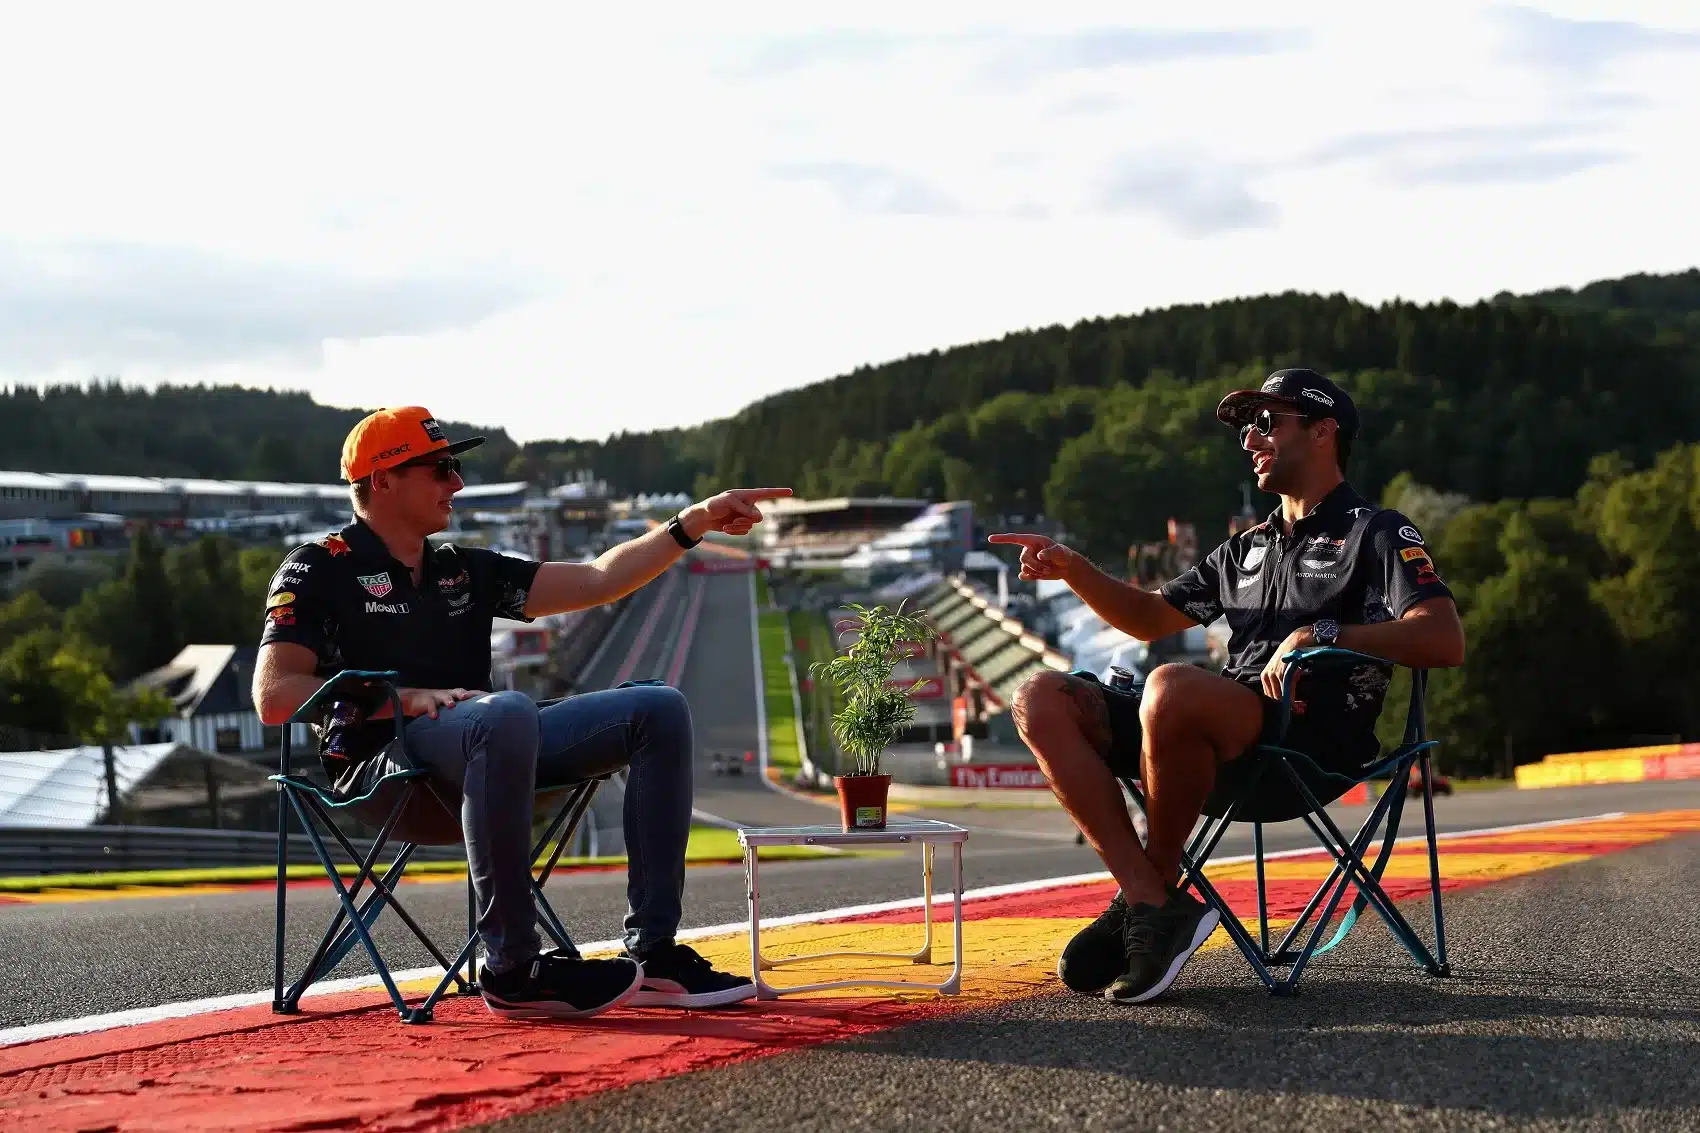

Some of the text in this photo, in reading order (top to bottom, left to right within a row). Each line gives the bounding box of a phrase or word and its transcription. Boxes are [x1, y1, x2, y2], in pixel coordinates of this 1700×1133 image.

[380, 443, 412, 460] exact
[360, 575, 387, 585] TAG
[957, 767, 985, 789] Fly
